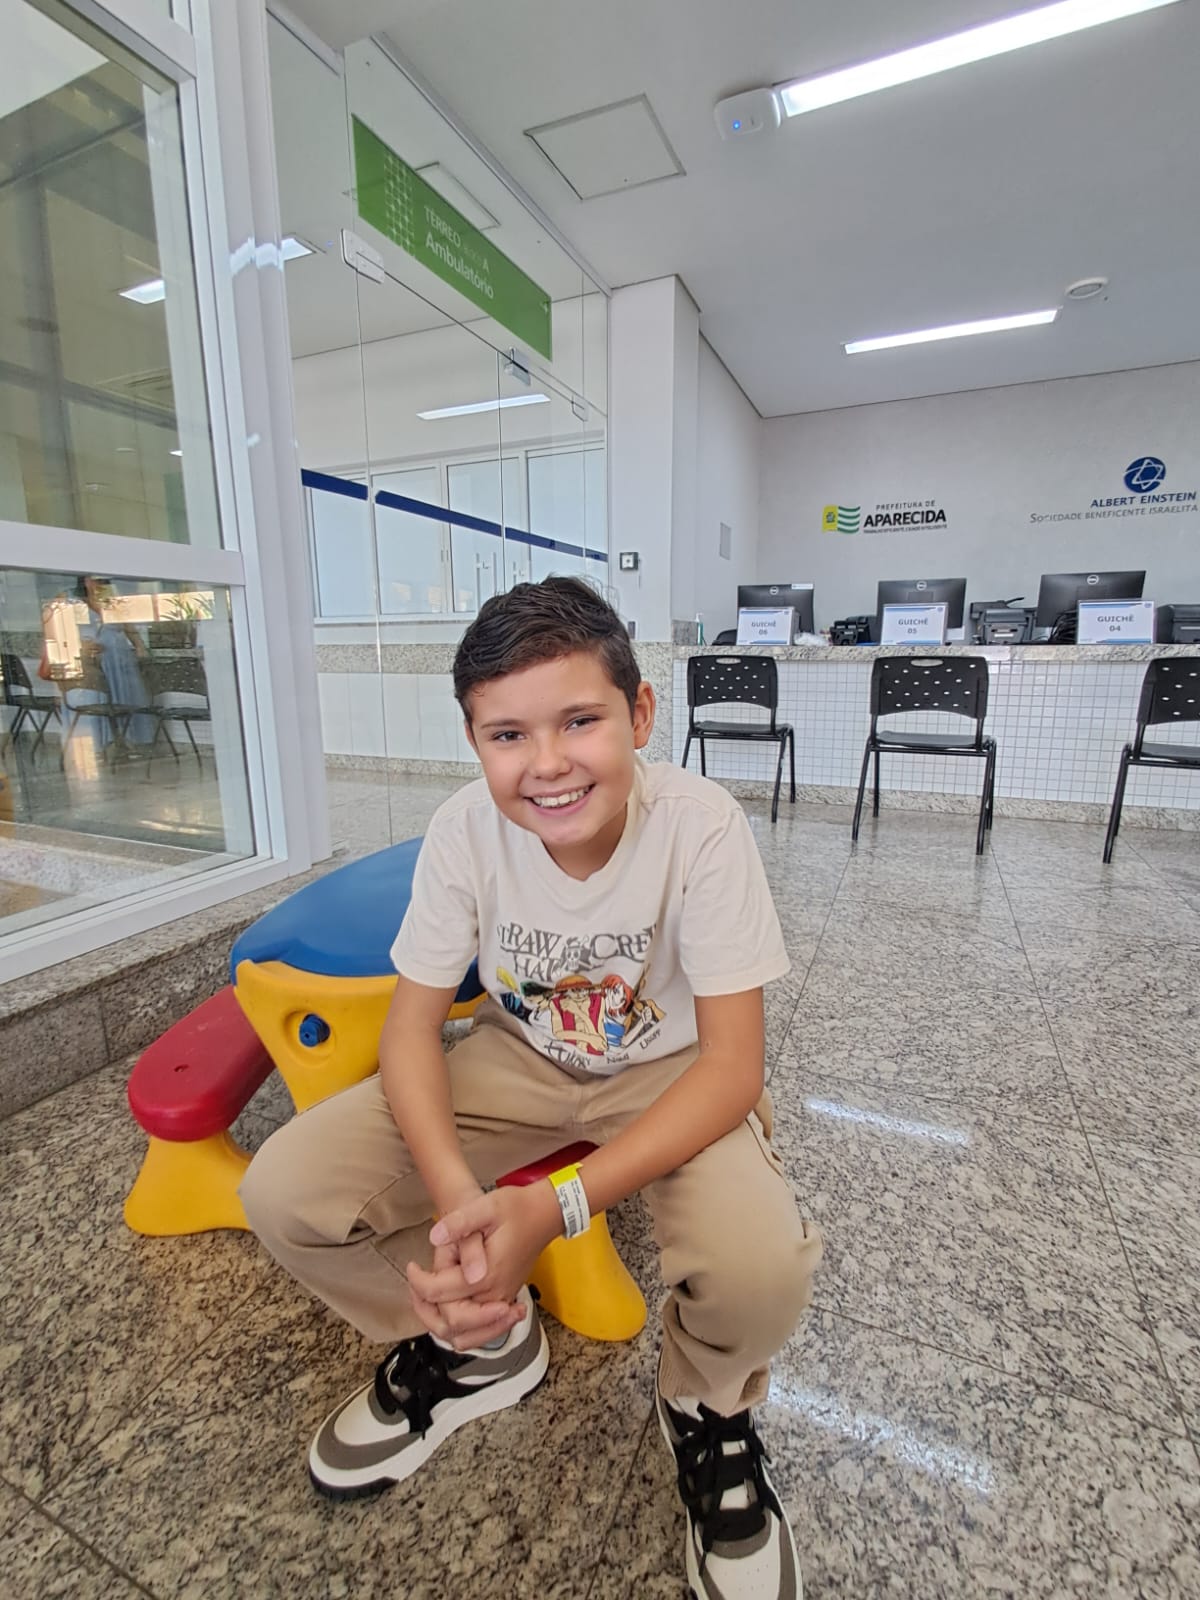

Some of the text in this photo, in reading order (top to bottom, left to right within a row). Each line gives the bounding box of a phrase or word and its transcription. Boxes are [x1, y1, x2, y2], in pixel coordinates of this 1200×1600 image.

[425, 231, 494, 299] Ambulatório
[876, 501, 922, 511] PREFEITURA
[1090, 491, 1197, 508] ALBERT EINSTEIN
[863, 509, 947, 528] APARECIDA
[1085, 507, 1145, 519] BENEFICENTE
[1149, 504, 1198, 514] ISRAELITA
